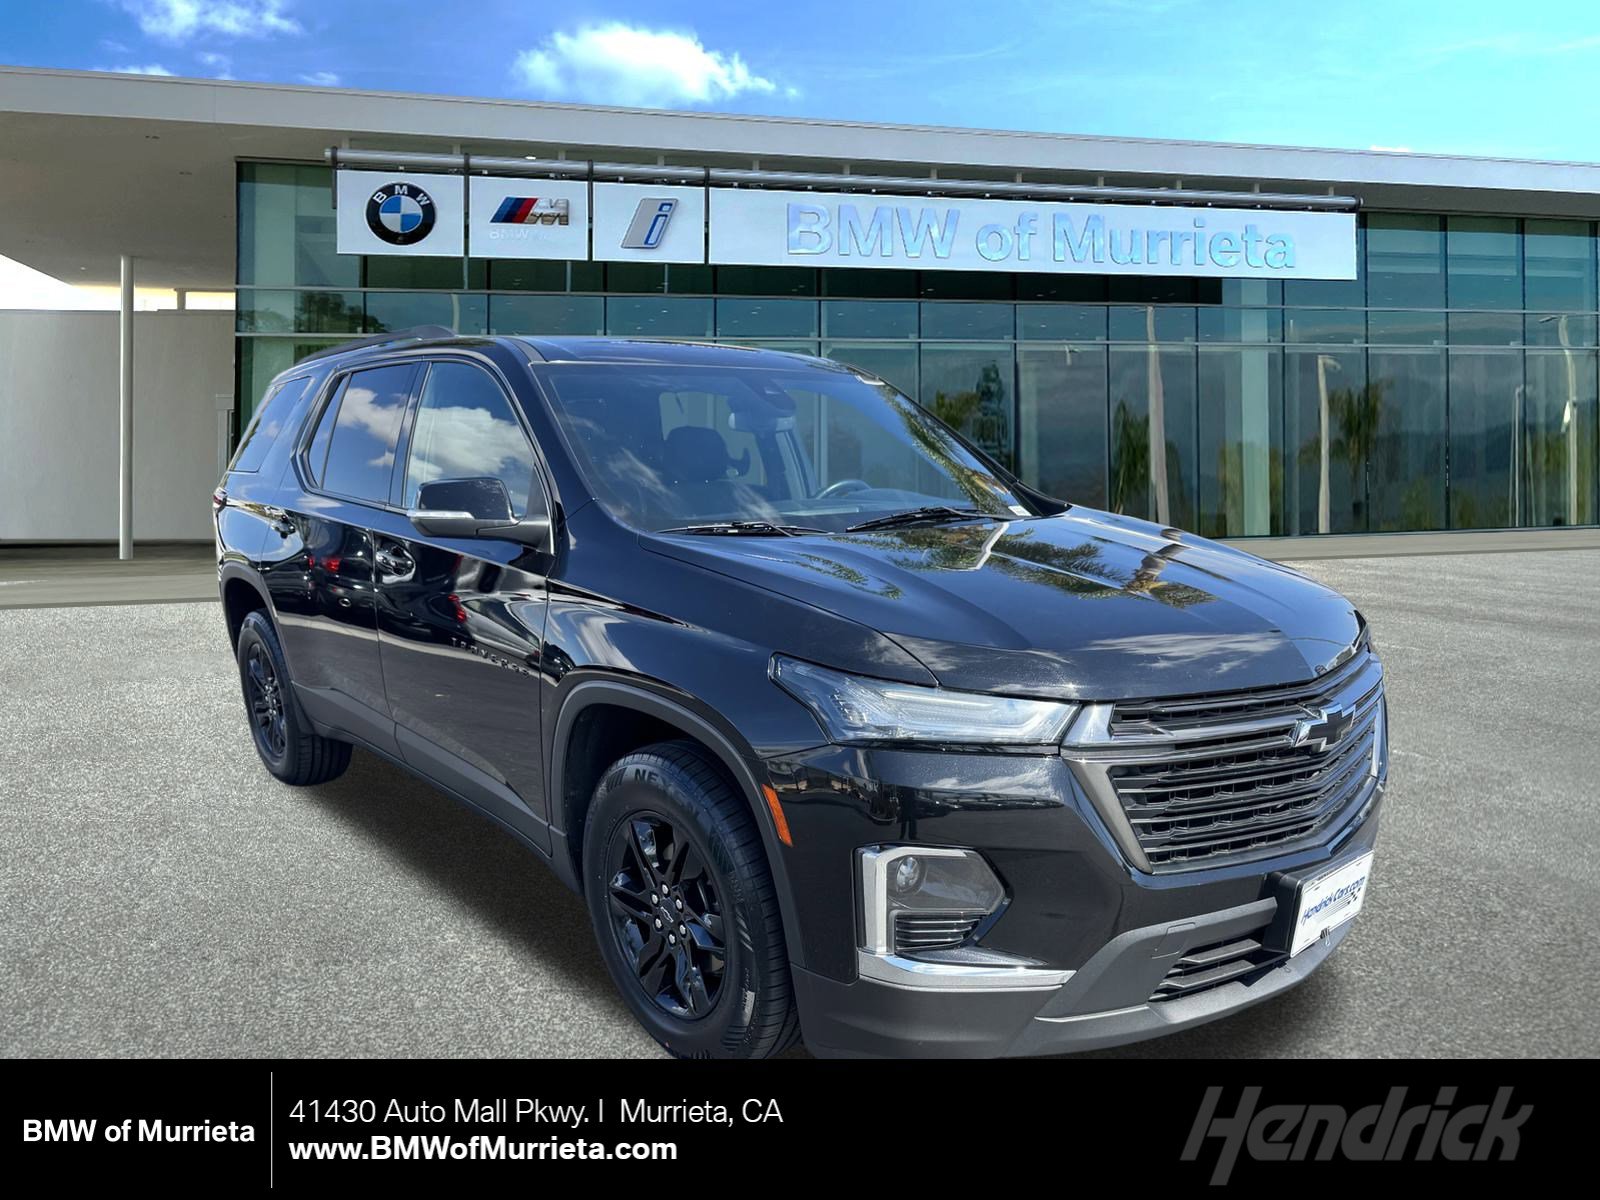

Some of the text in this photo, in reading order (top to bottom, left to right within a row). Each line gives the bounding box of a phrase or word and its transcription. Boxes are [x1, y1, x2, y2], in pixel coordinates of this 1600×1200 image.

[373, 184, 429, 206] BMW
[787, 202, 1296, 269] BMW of Murrieta
